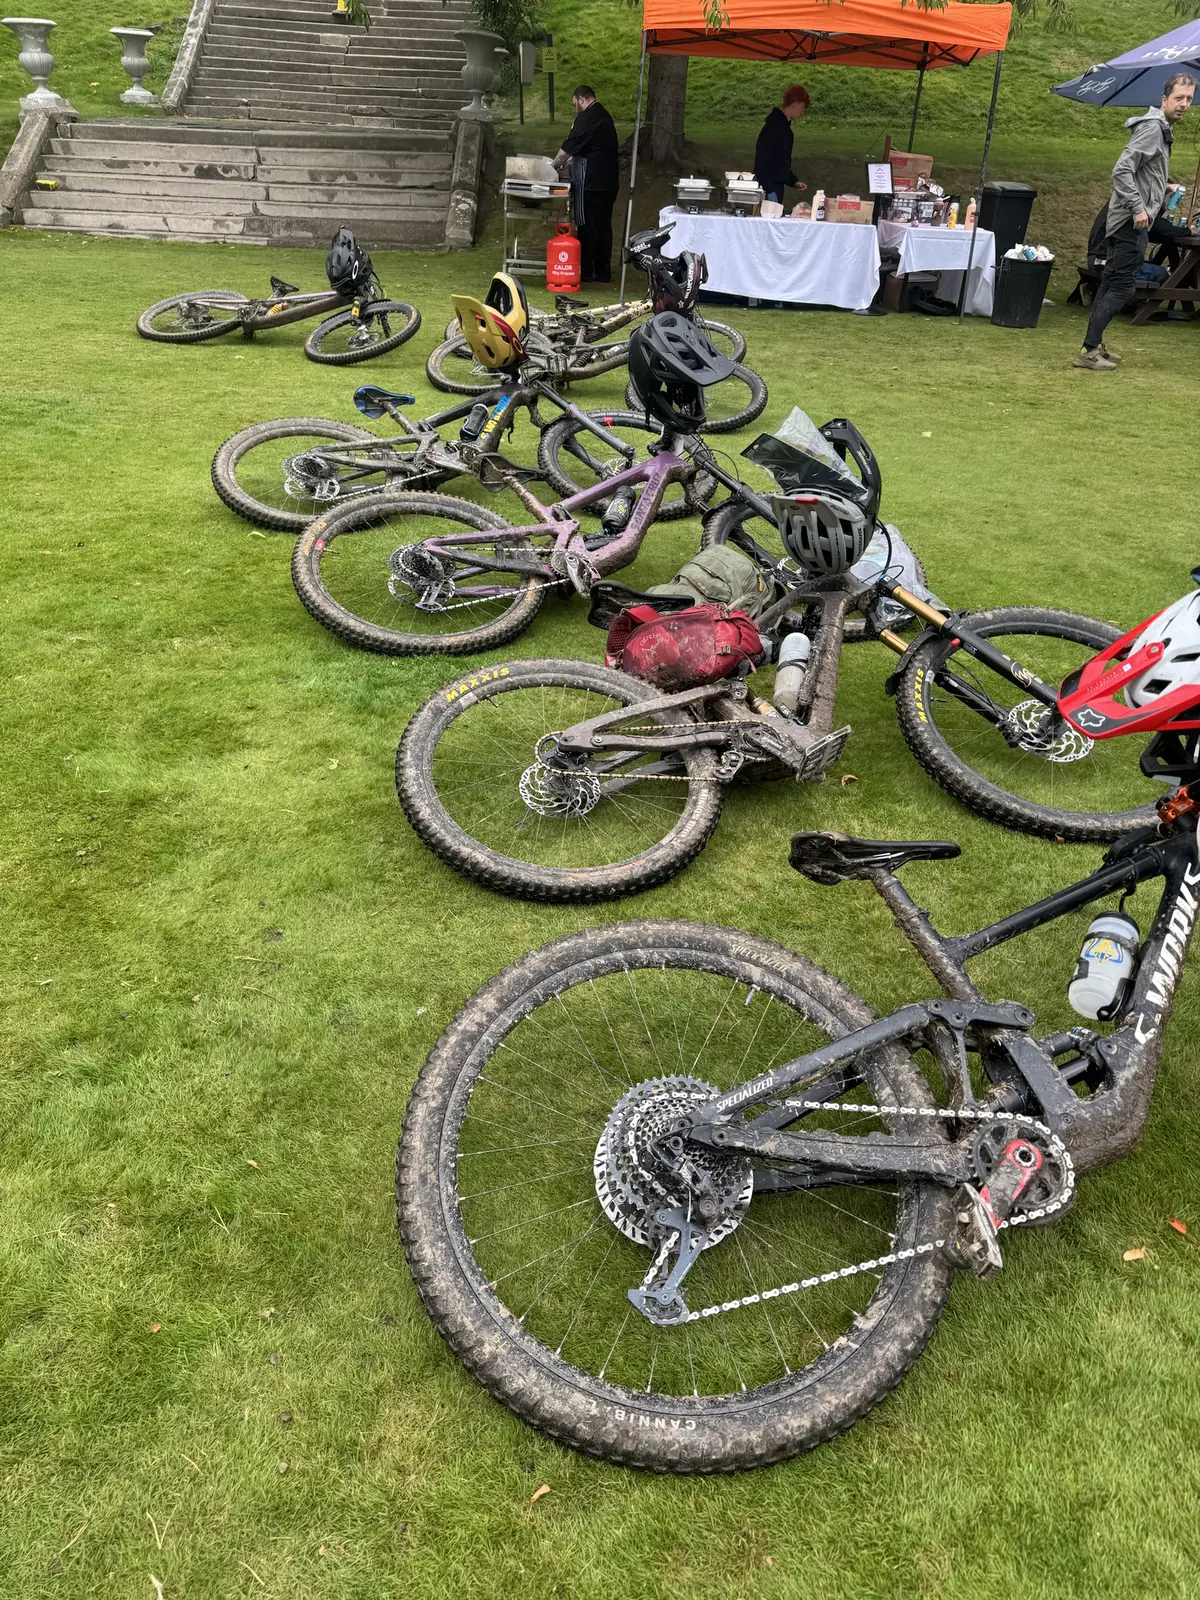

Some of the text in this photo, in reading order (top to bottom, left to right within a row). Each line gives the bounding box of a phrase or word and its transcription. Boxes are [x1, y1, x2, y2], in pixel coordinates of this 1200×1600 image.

[630, 472, 662, 530] SANTA CRUZ
[446, 667, 510, 702] MAXXIS
[914, 668, 929, 723] MAXXIS
[717, 1076, 774, 1113] SPECIALIZED
